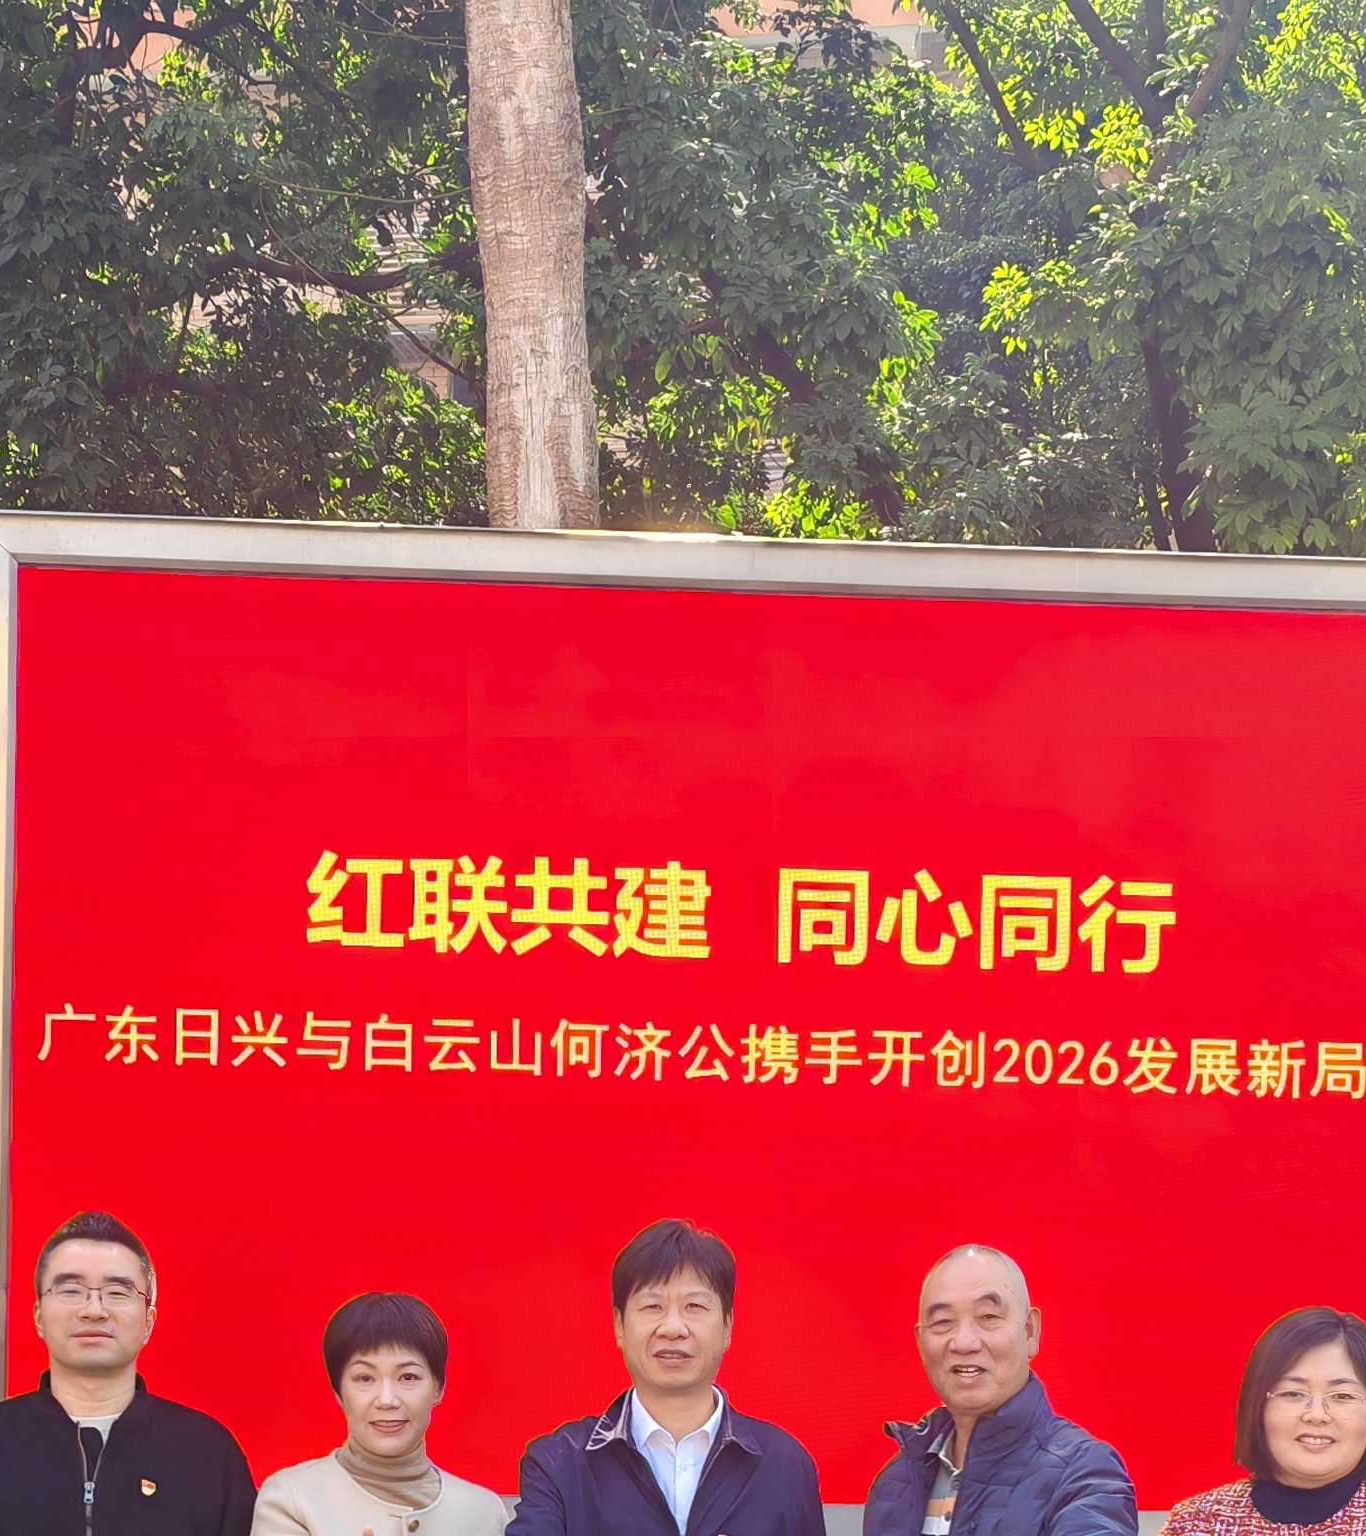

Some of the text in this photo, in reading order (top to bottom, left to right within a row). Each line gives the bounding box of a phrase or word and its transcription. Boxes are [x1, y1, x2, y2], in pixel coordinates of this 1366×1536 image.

[306, 850, 1177, 974] 红联共建 同心同行
